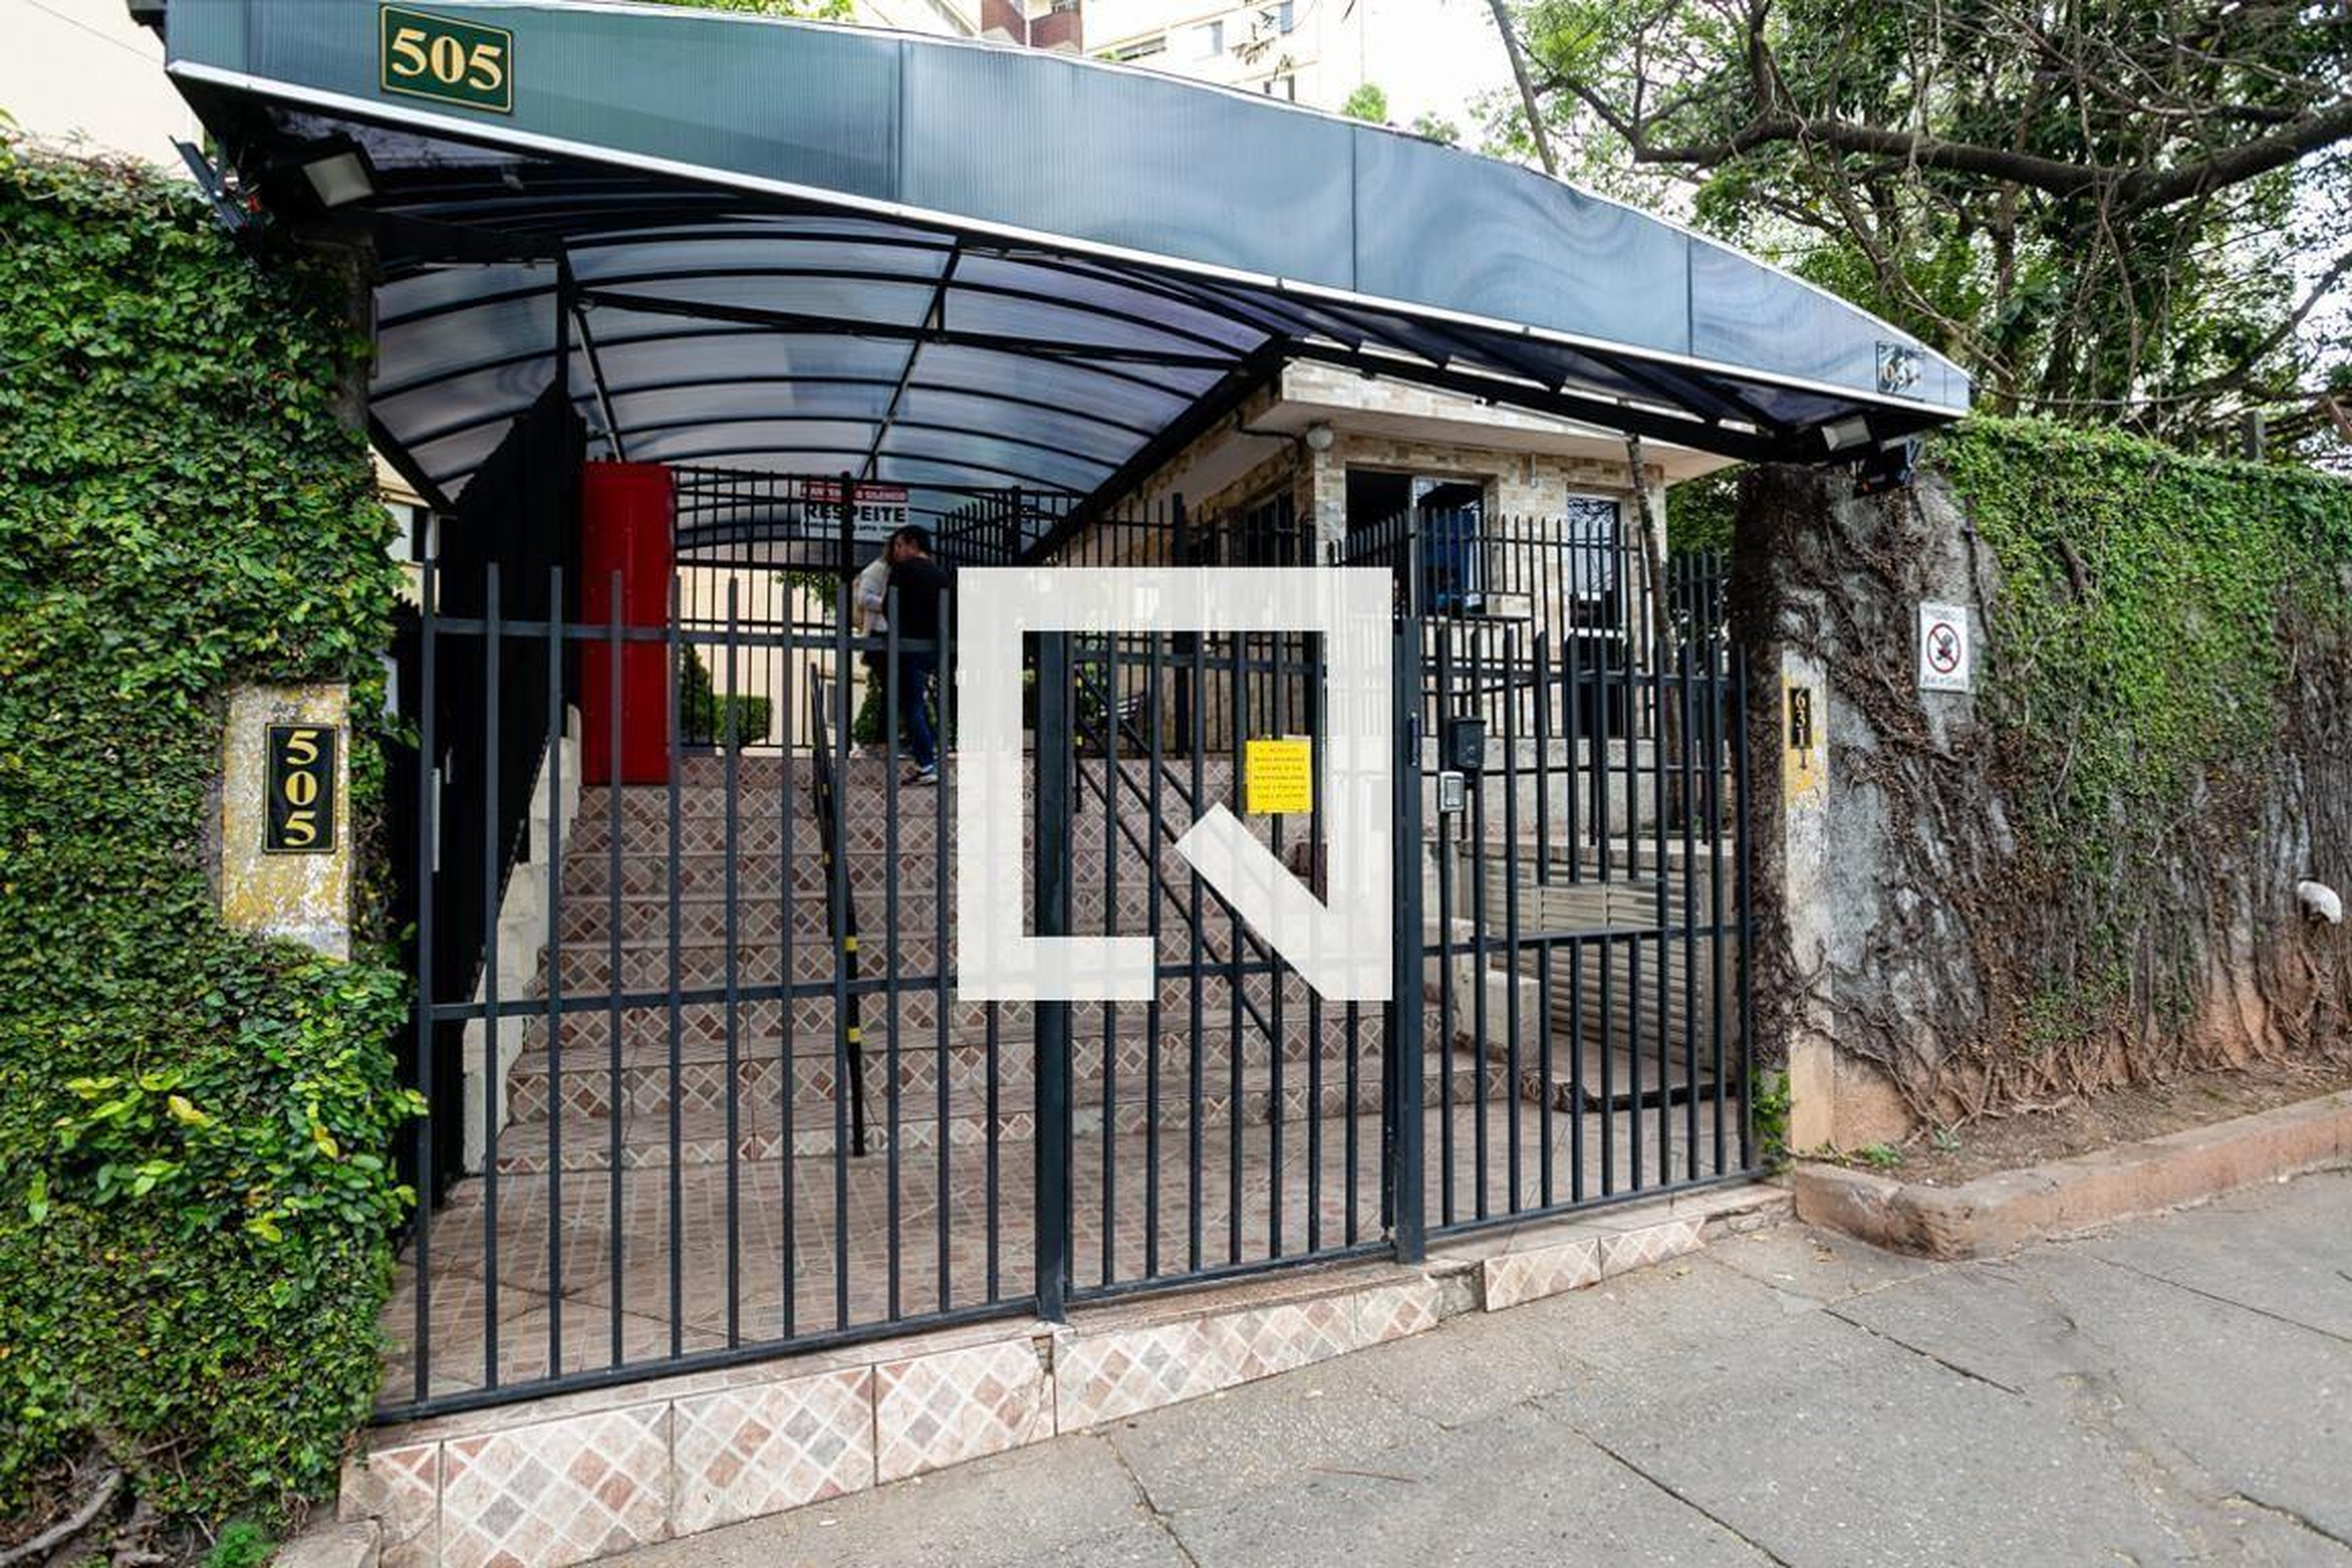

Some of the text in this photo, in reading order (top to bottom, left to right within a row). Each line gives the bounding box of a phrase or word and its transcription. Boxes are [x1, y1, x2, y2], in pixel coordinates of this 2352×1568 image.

[391, 28, 502, 90] 505
[1795, 687, 1806, 747] 631
[284, 730, 318, 846] 505
